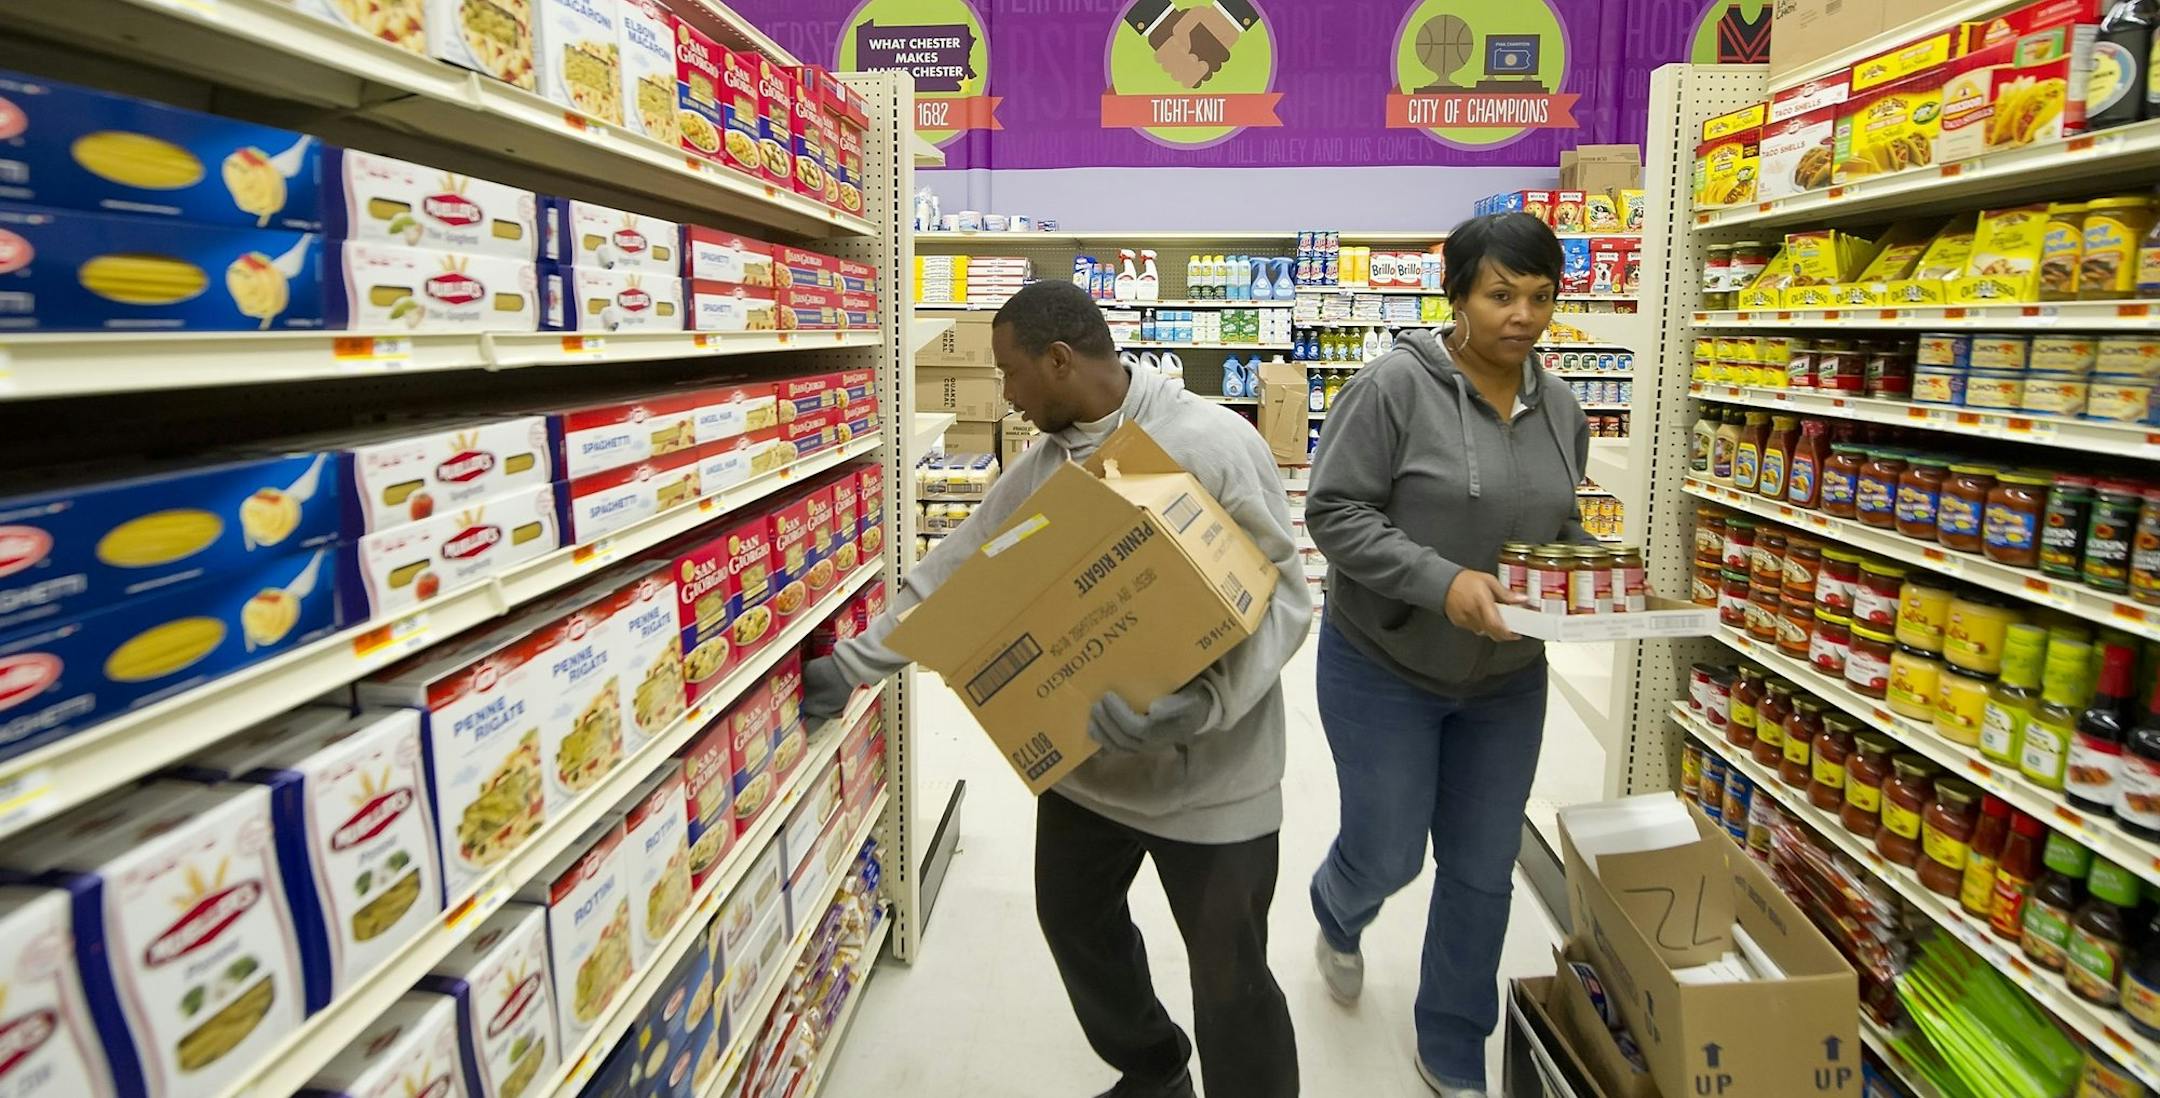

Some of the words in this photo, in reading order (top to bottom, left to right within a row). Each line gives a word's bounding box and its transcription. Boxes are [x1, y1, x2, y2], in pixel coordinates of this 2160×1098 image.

[689, 39, 708, 60] SAN
[869, 38, 906, 50] WHAT
[909, 37, 961, 49] CHESTER
[895, 52, 938, 63] MAKES
[734, 64, 750, 83] SAN
[769, 73, 784, 93] SAN
[912, 66, 963, 77] CHESTER
[917, 102, 949, 126] 1682
[1151, 98, 1226, 124] TIGHT-KNIT
[1408, 99, 1439, 123] CITY
[1444, 99, 1462, 123] OF
[1467, 98, 1548, 124] CHAMPIONS
[1775, 106, 1793, 117] TACO
[1793, 99, 1822, 112] SHELLS
[1263, 138, 1305, 163] HALEY
[1313, 137, 1343, 162] AND
[1350, 136, 1371, 162] HIS
[1377, 136, 1434, 161] COMETS
[1761, 148, 1777, 158] TACO
[1780, 141, 1805, 153] SHELLS
[700, 251, 729, 264] SPAGHETTI
[1372, 264, 1395, 276] Brillo
[1398, 264, 1421, 276] Brillo
[1743, 293, 1754, 305] OLD
[1791, 292, 1804, 304] OLD
[1836, 291, 1849, 303] OLD
[1891, 288, 1906, 301] OLD
[1961, 283, 1978, 298] OLD
[703, 303, 732, 315] SPAGHETTI
[582, 435, 631, 455] SPAGHETTI
[590, 494, 638, 518] SPAGHETTI
[785, 516, 800, 532] SAN
[740, 534, 760, 551] SAN
[1112, 520, 1154, 562] PENNE
[694, 558, 716, 581] SAN
[729, 542, 770, 575] GIORGIO
[681, 566, 729, 604] GIORGIO
[1074, 554, 1117, 595] RIGATE
[629, 606, 660, 632] PENNE
[641, 611, 672, 639] RIGATE
[1104, 610, 1138, 645] SAN
[553, 645, 593, 678] PENNE
[569, 650, 608, 684] RIGATE
[1036, 635, 1105, 698] GIORGIO
[778, 671, 794, 690] SAN
[453, 695, 506, 738] PENNE
[474, 699, 526, 744] RIGATE
[744, 704, 763, 726] SAN
[734, 707, 771, 751] GIORGIO
[697, 745, 718, 775] SAN
[1012, 731, 1053, 770] 80173
[686, 748, 729, 801] GIORGIO
[645, 813, 677, 855] ROTINI
[574, 874, 615, 926] ROTINI
[1695, 1074, 1732, 1096] UP
[1815, 1067, 1852, 1091] UP
